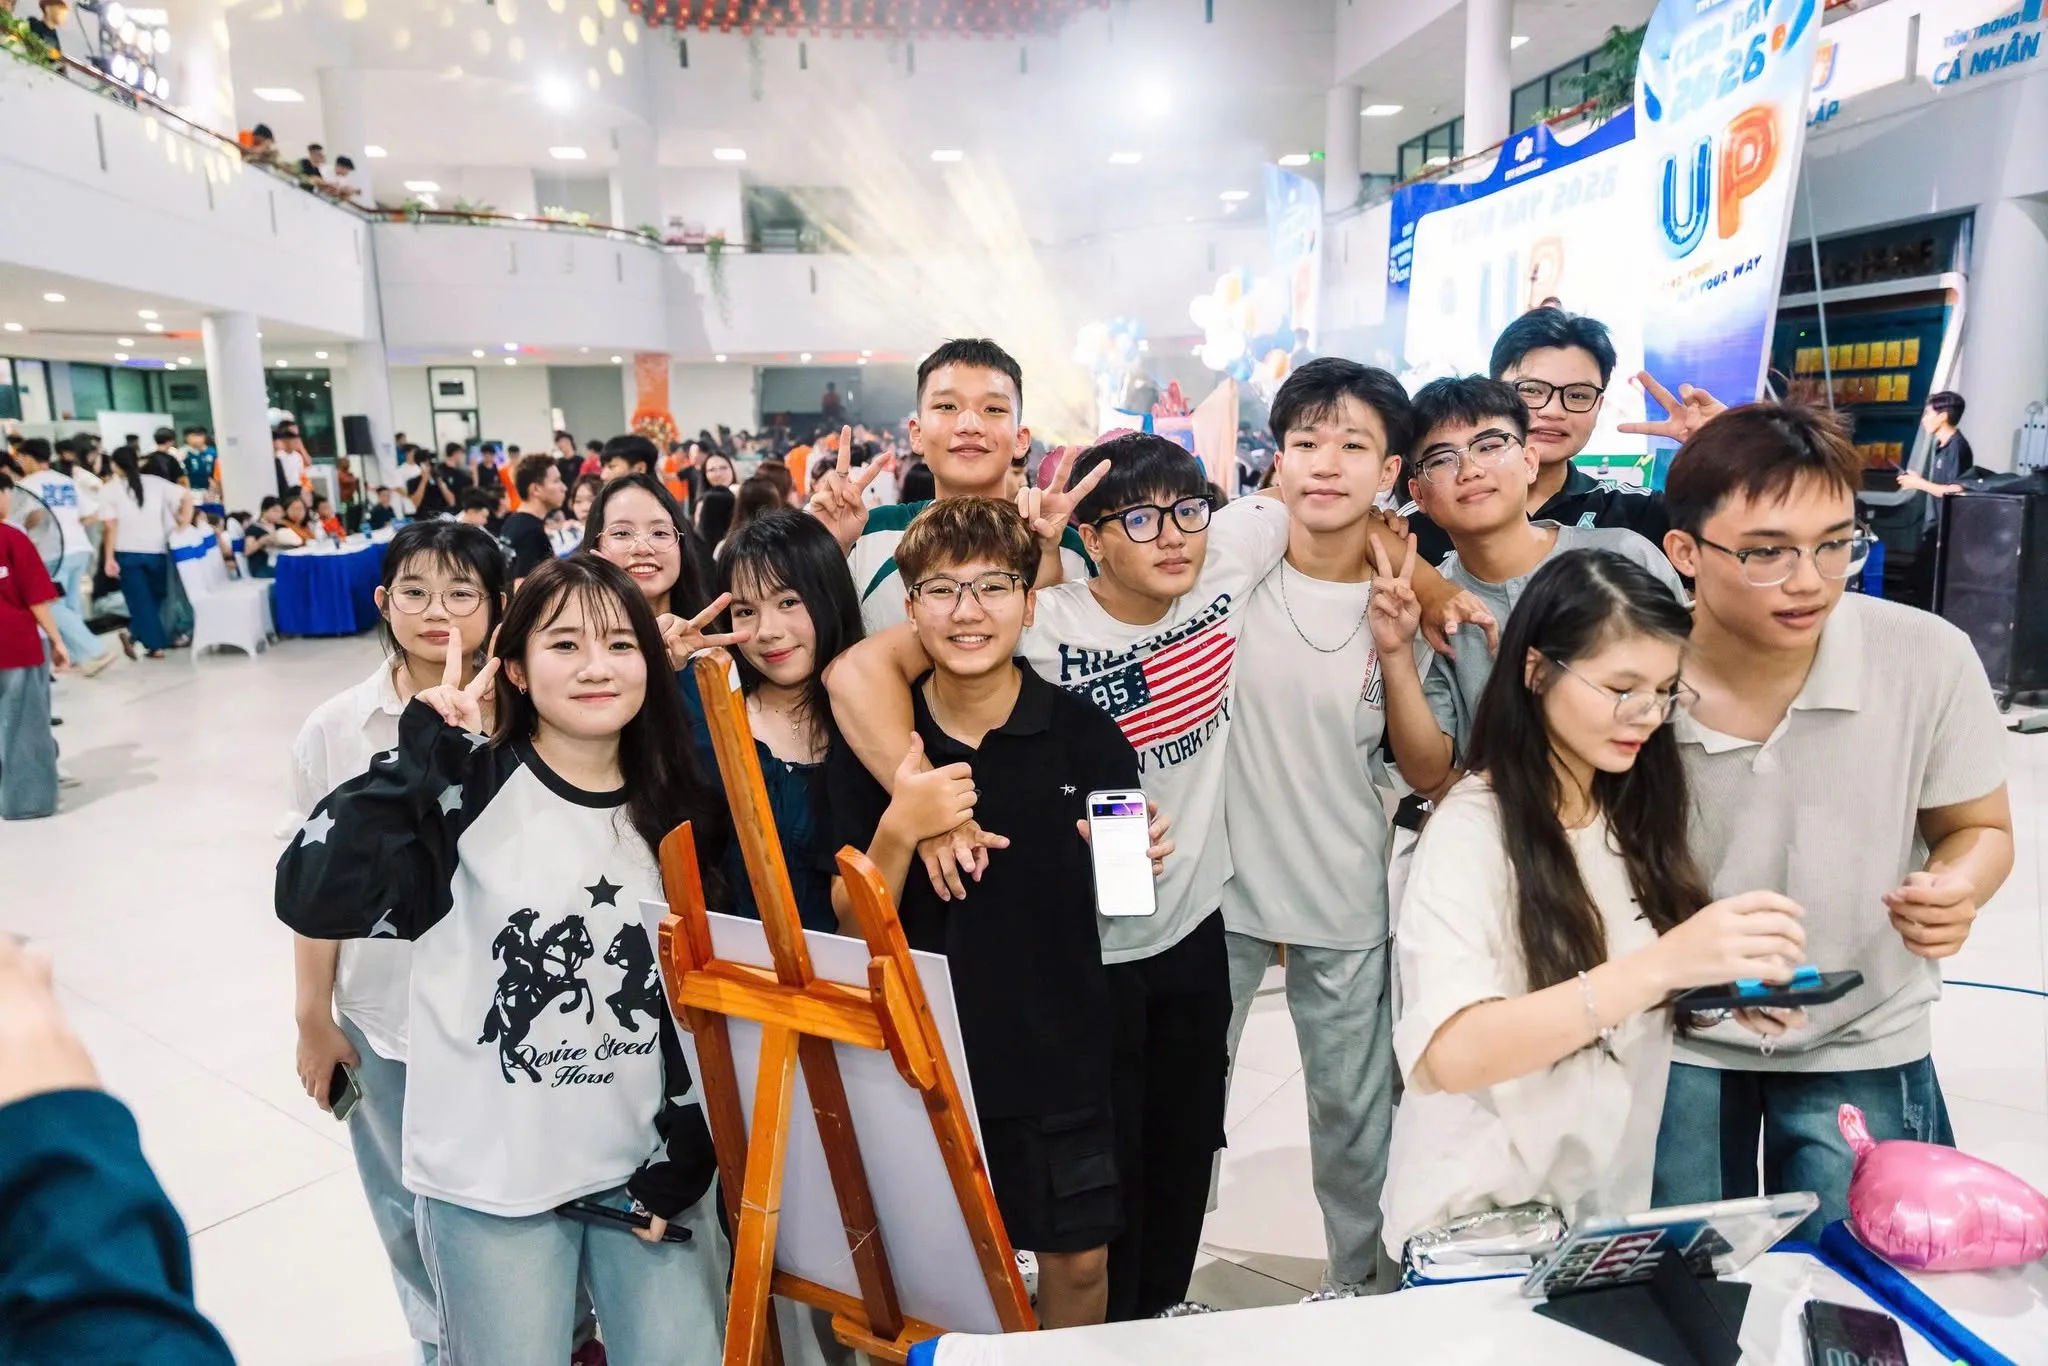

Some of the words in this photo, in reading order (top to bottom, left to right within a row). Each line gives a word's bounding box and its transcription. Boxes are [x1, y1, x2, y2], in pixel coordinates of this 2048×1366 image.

[1933, 49, 1962, 85] CÁ
[1969, 31, 2041, 76] NHÂN
[1658, 104, 1780, 259] UP
[1700, 270, 1728, 294] YOUR
[1733, 254, 1762, 278] WAY
[1091, 679, 1129, 710] 95
[1150, 727, 1203, 769] YORK
[504, 1040, 588, 1069] Desire
[594, 1031, 658, 1061] Steed
[551, 1064, 615, 1088] Horse
